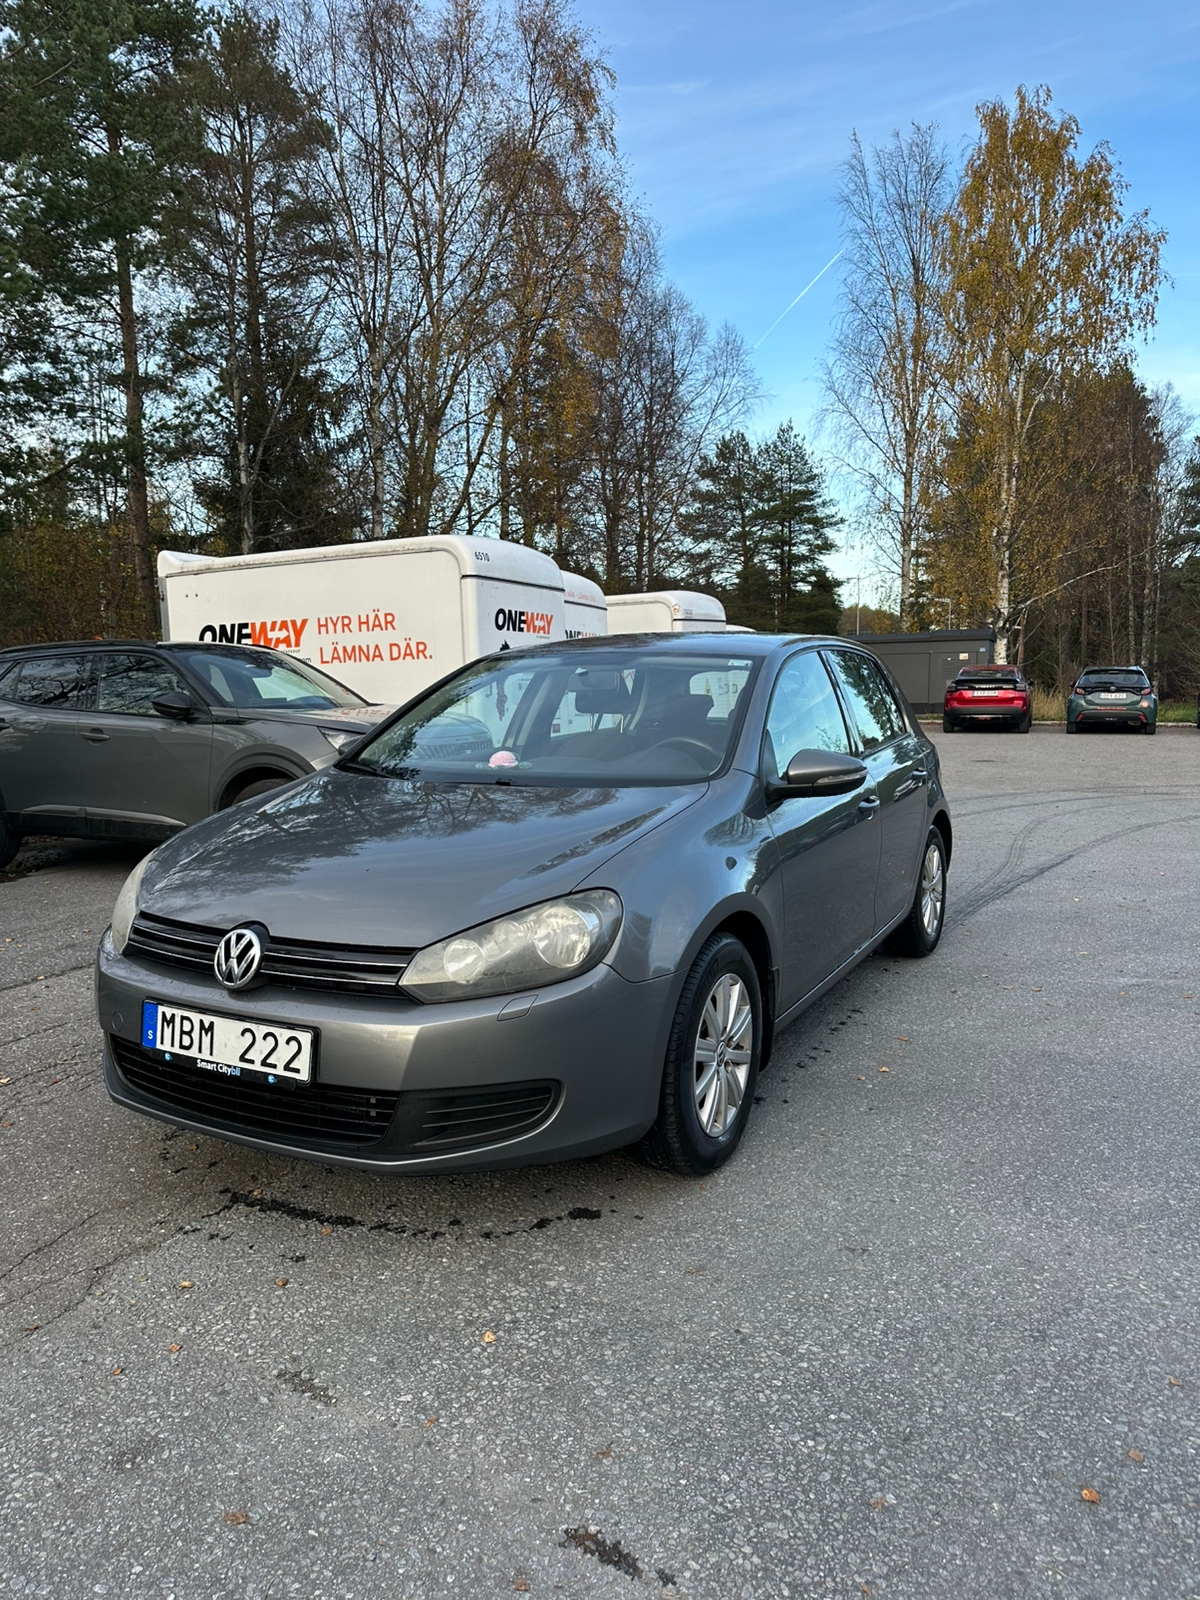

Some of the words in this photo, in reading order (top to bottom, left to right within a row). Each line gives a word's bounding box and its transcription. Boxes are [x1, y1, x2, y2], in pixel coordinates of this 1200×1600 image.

[474, 551, 490, 562] 6510
[198, 618, 309, 649] ONEWAY
[317, 615, 353, 635] HYR
[357, 608, 396, 632] HÄR
[494, 608, 553, 635] ONEWAY
[319, 641, 384, 664] LÄMNA
[389, 637, 433, 661] DÄR.
[147, 1030, 154, 1040] S
[160, 1011, 215, 1057] MBM
[239, 1027, 303, 1074] 222
[196, 1059, 216, 1071] Smart
[218, 1063, 241, 1076] Citybil
